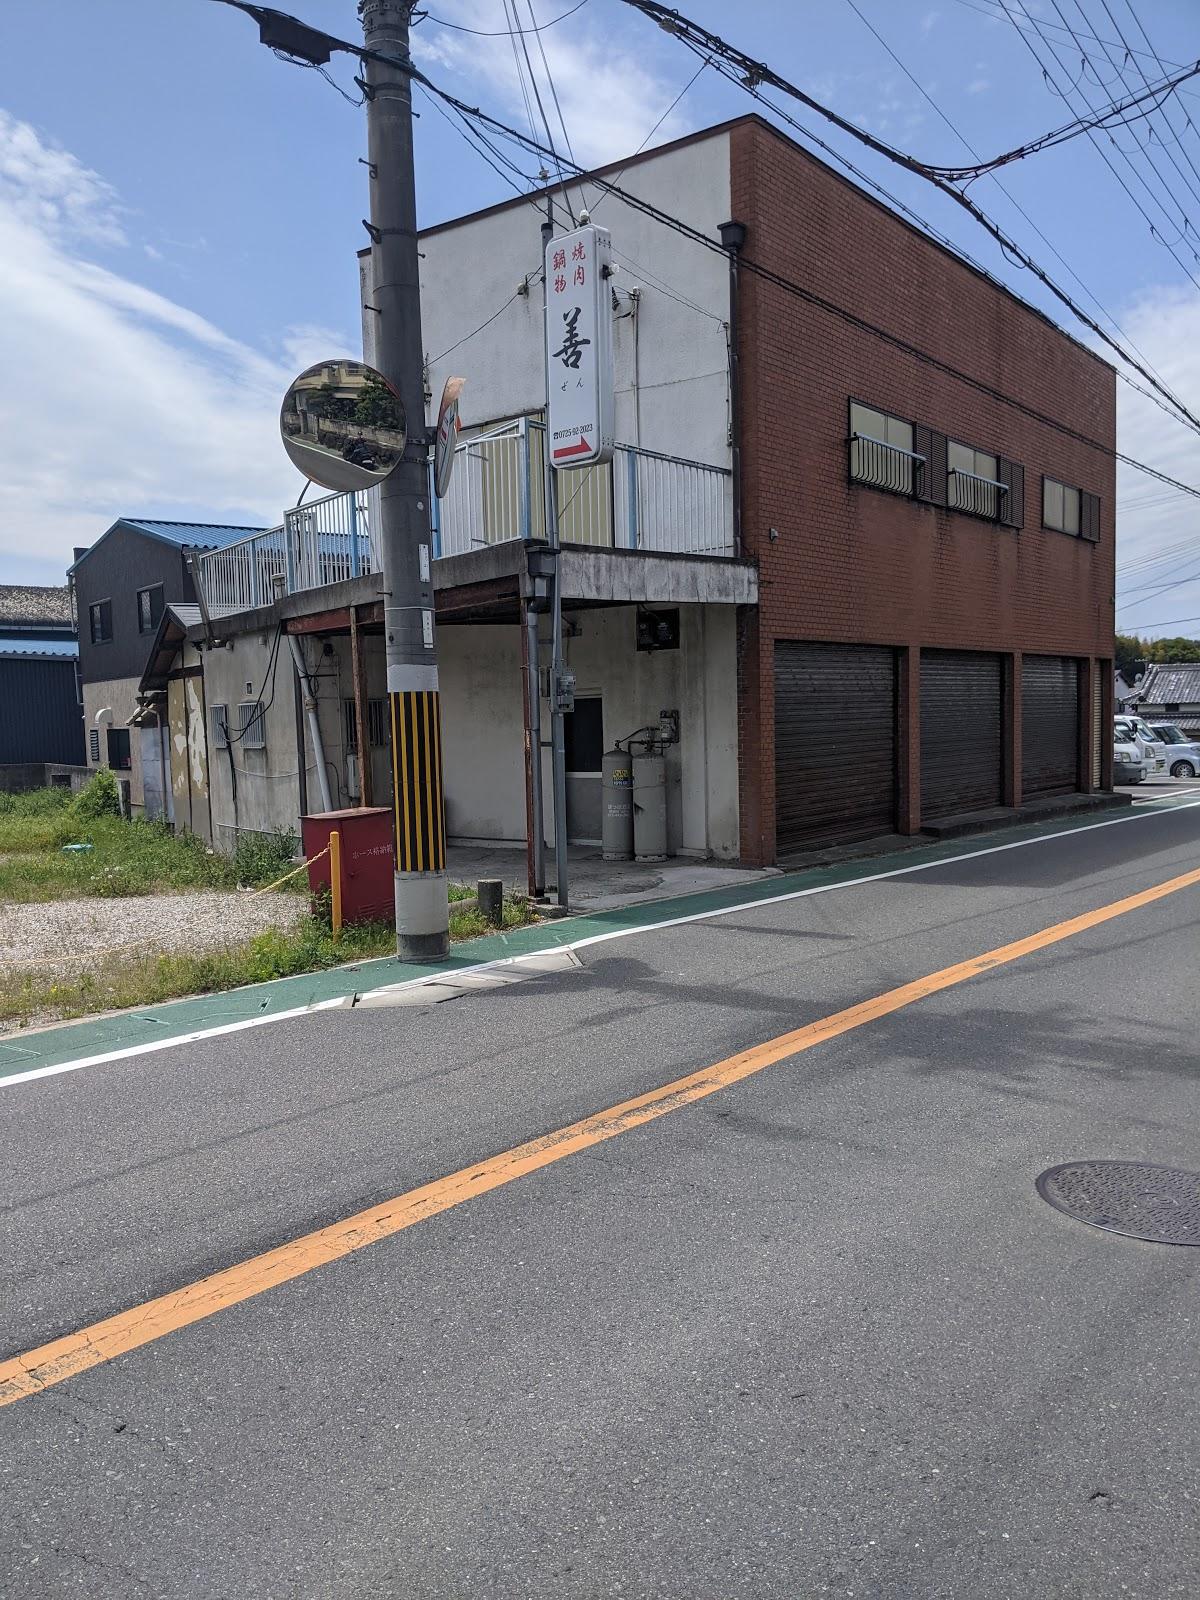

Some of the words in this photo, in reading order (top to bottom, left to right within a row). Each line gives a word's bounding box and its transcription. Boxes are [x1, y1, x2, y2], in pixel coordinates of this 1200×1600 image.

[553, 249, 567, 293] 鍋物
[572, 241, 586, 286] 焼肉
[552, 307, 591, 369] 善
